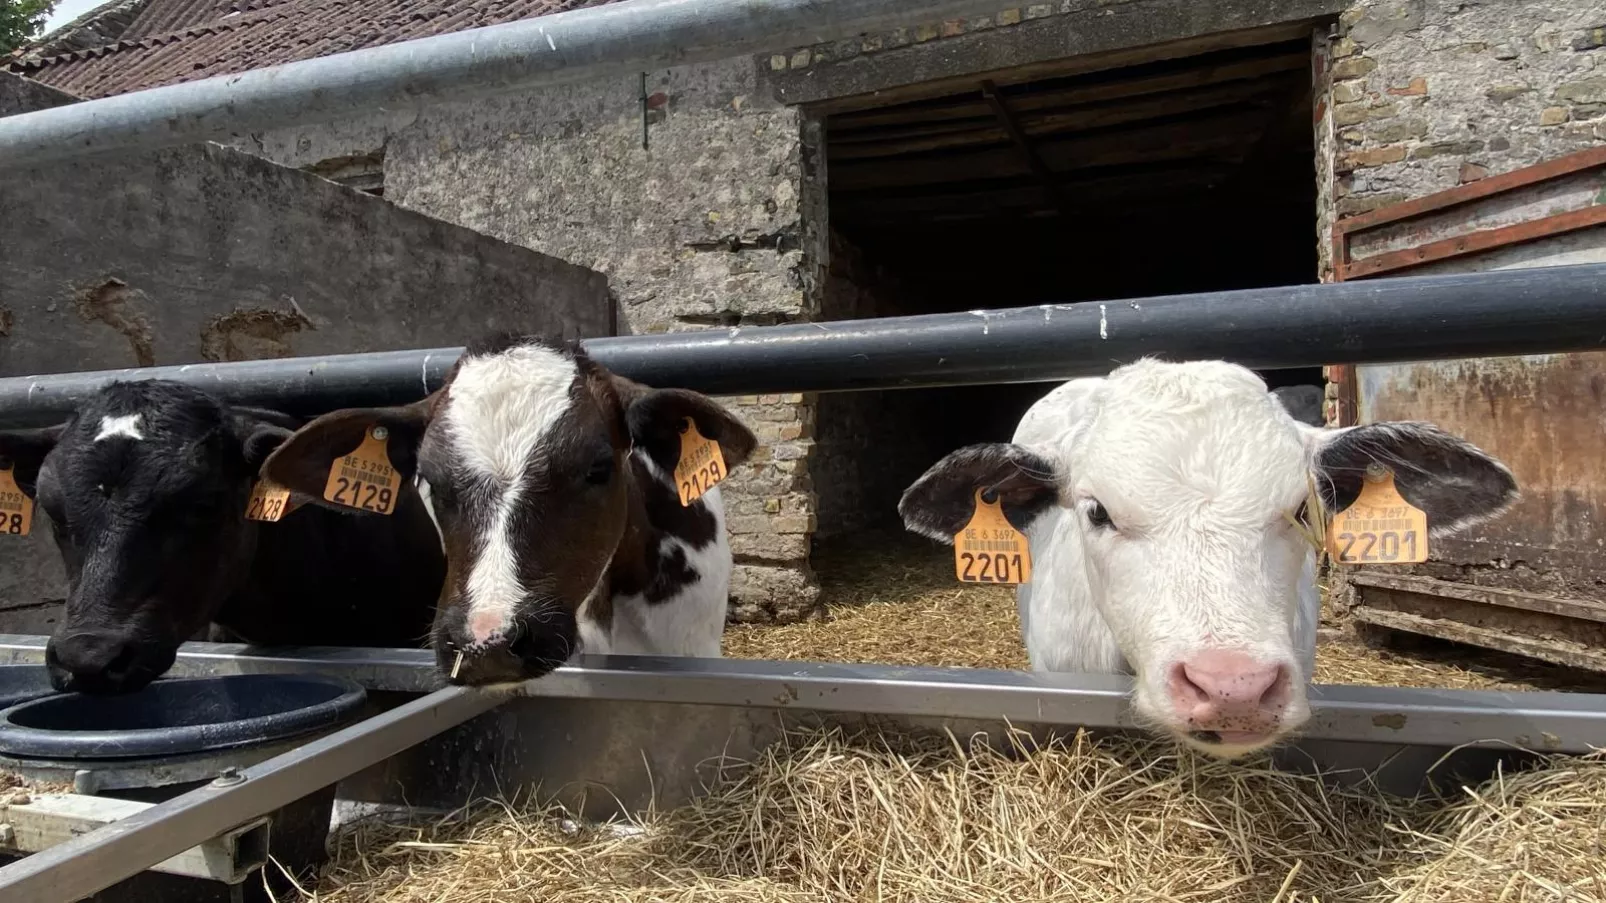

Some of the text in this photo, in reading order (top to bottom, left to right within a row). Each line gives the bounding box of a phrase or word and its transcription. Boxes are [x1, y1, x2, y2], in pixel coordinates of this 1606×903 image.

[344, 456, 358, 468] BE
[361, 460, 368, 470] 5
[333, 477, 392, 512] 2129
[682, 460, 721, 503] 2129
[248, 497, 282, 519] 2128
[965, 528, 1015, 540] BE 6 3697
[1337, 530, 1417, 562] 2201
[961, 552, 1023, 583] 2201
